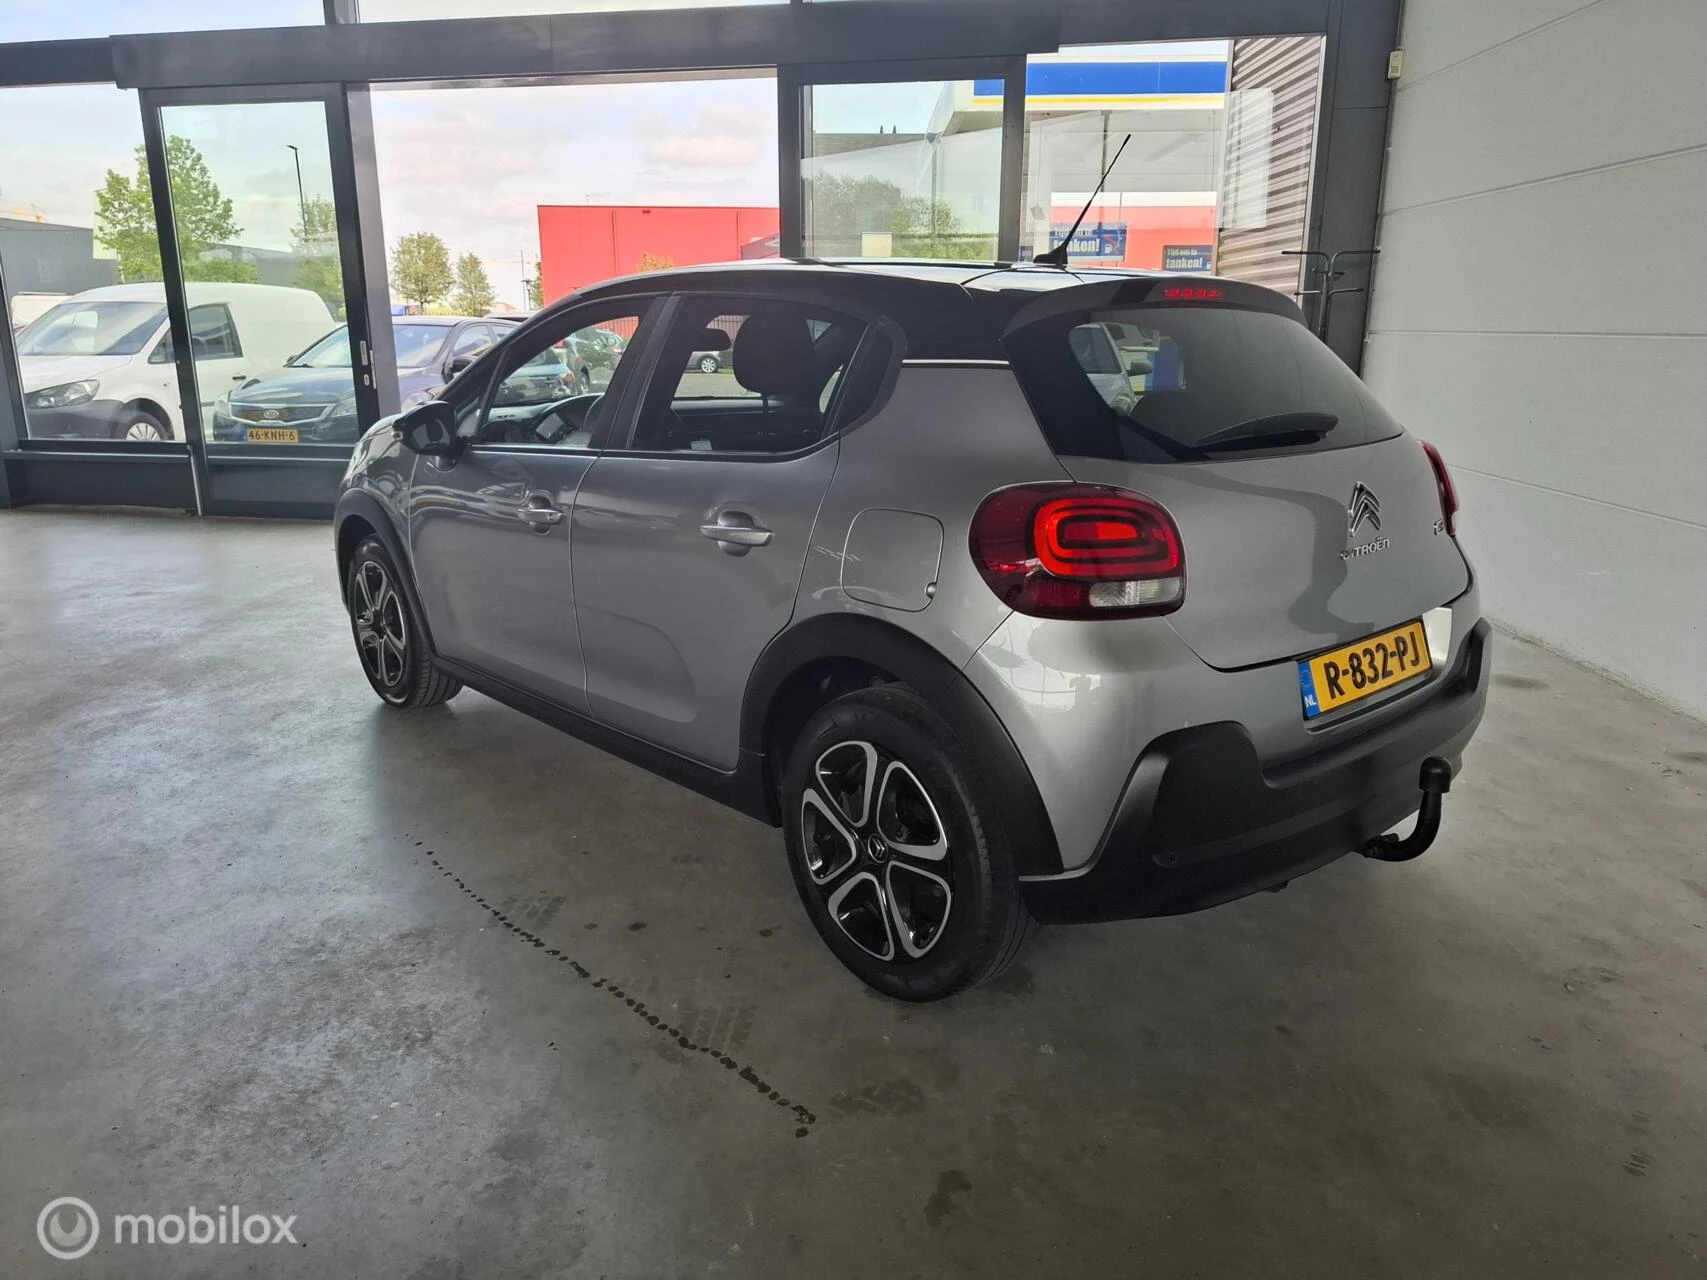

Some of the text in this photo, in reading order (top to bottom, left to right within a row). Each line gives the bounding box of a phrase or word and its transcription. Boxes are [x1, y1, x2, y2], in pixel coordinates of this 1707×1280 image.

[1166, 258, 1203, 269] tanken!
[248, 430, 296, 441] 46-KNH-6
[1323, 631, 1420, 700] R-832-PJ
[1304, 695, 1317, 708] NL
